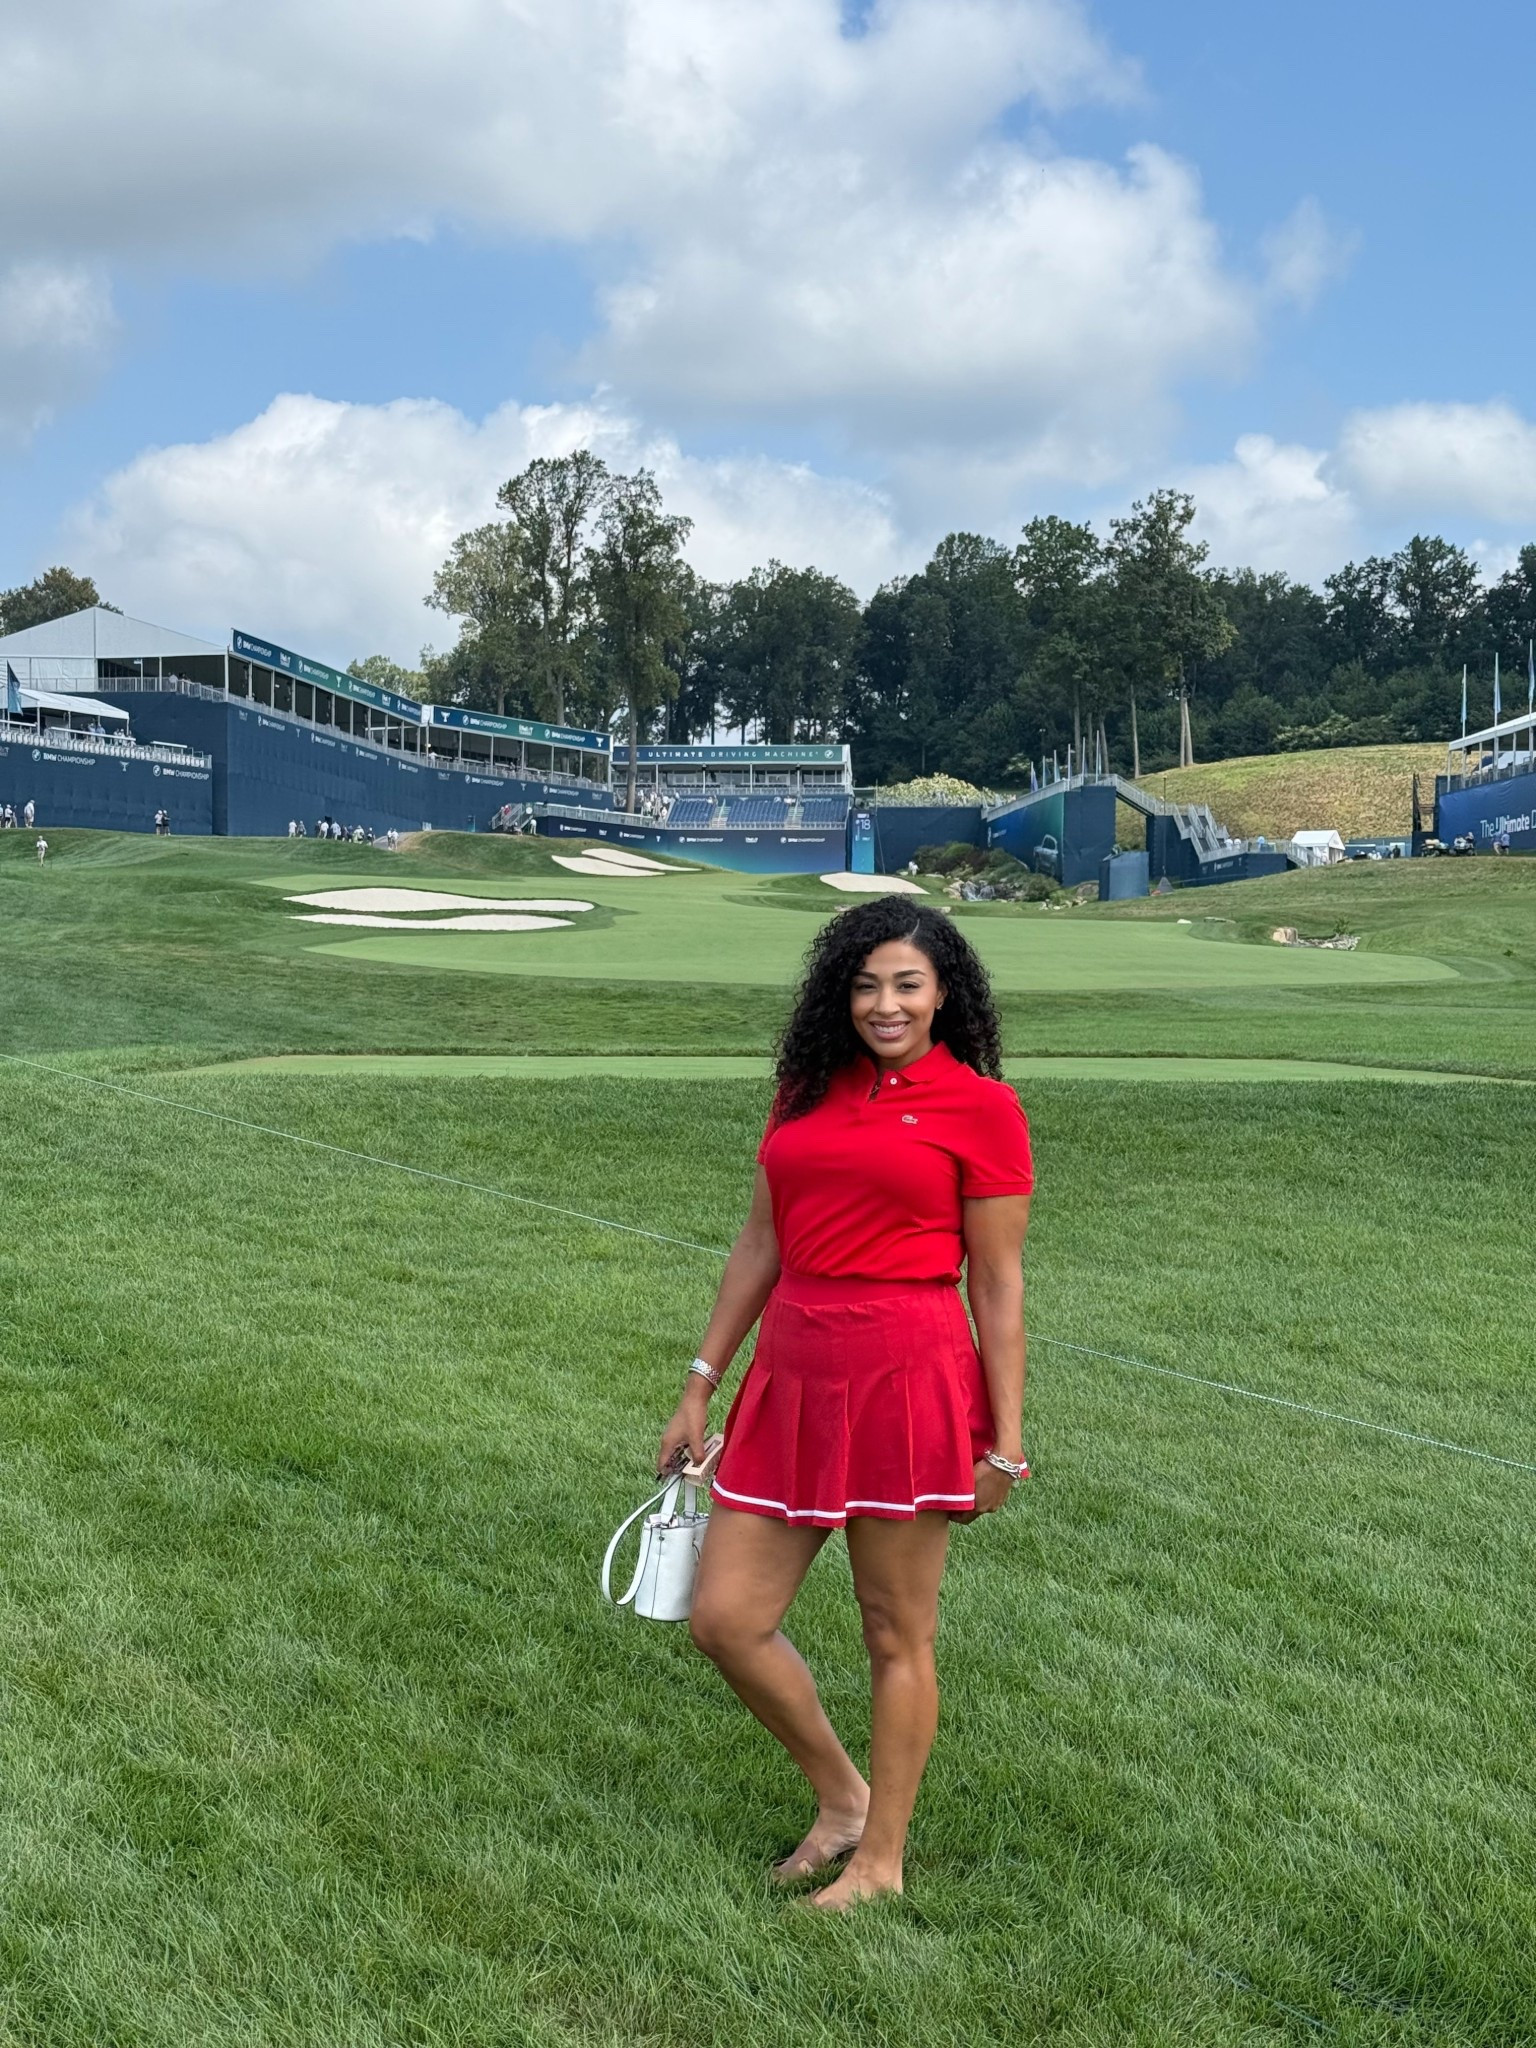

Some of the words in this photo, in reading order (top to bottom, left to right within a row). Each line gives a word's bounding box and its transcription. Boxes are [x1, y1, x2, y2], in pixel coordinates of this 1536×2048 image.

[43, 752, 57, 762] BMW
[860, 819, 871, 830] 18
[1480, 819, 1494, 838] The
[1494, 814, 1530, 835] Ultimate
